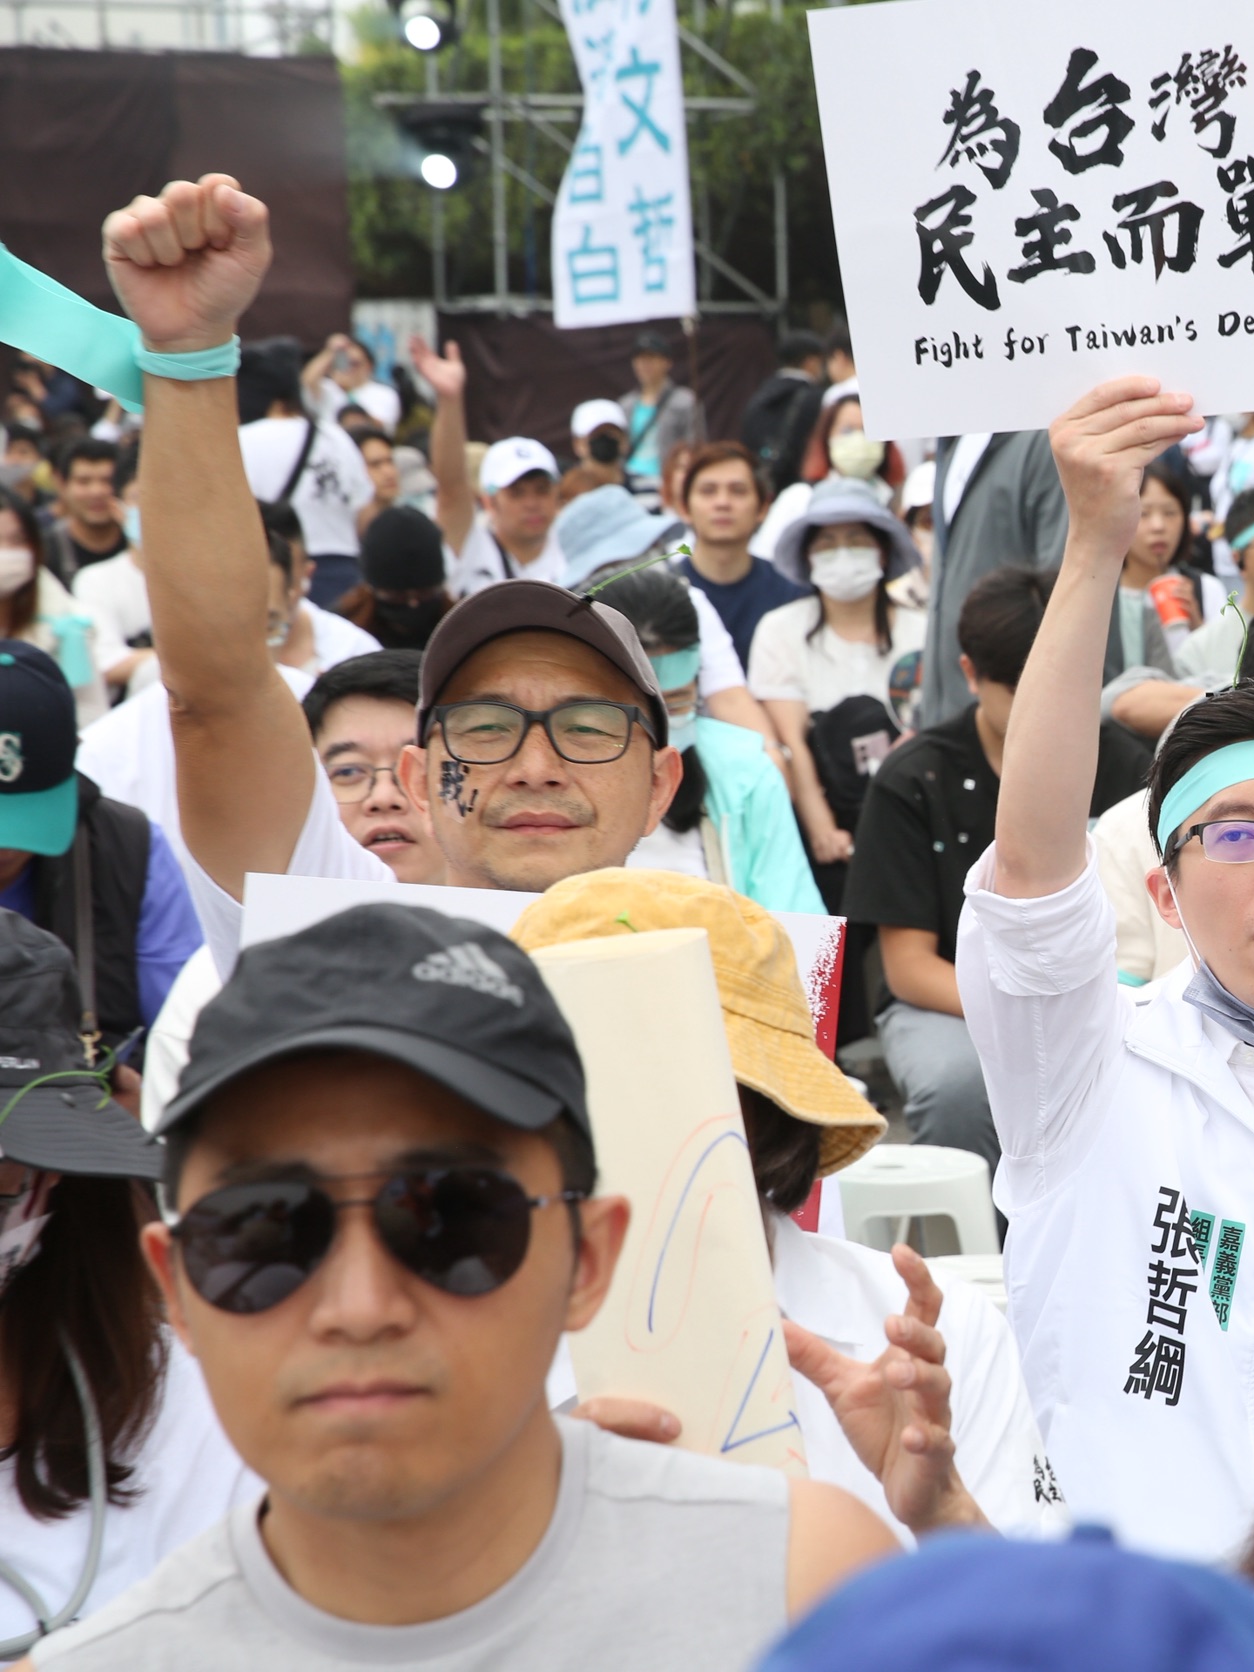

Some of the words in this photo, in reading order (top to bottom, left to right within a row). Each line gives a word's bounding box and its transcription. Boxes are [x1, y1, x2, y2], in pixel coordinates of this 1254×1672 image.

[614, 0, 674, 292] 文哲
[935, 44, 1248, 190] 為台灣
[914, 331, 984, 368] Fight
[1003, 327, 1050, 361] for
[1065, 315, 1199, 352] Taiwan's
[1122, 1185, 1200, 1407] 張哲綱
[1211, 1225, 1243, 1325] 嘉義黨部
